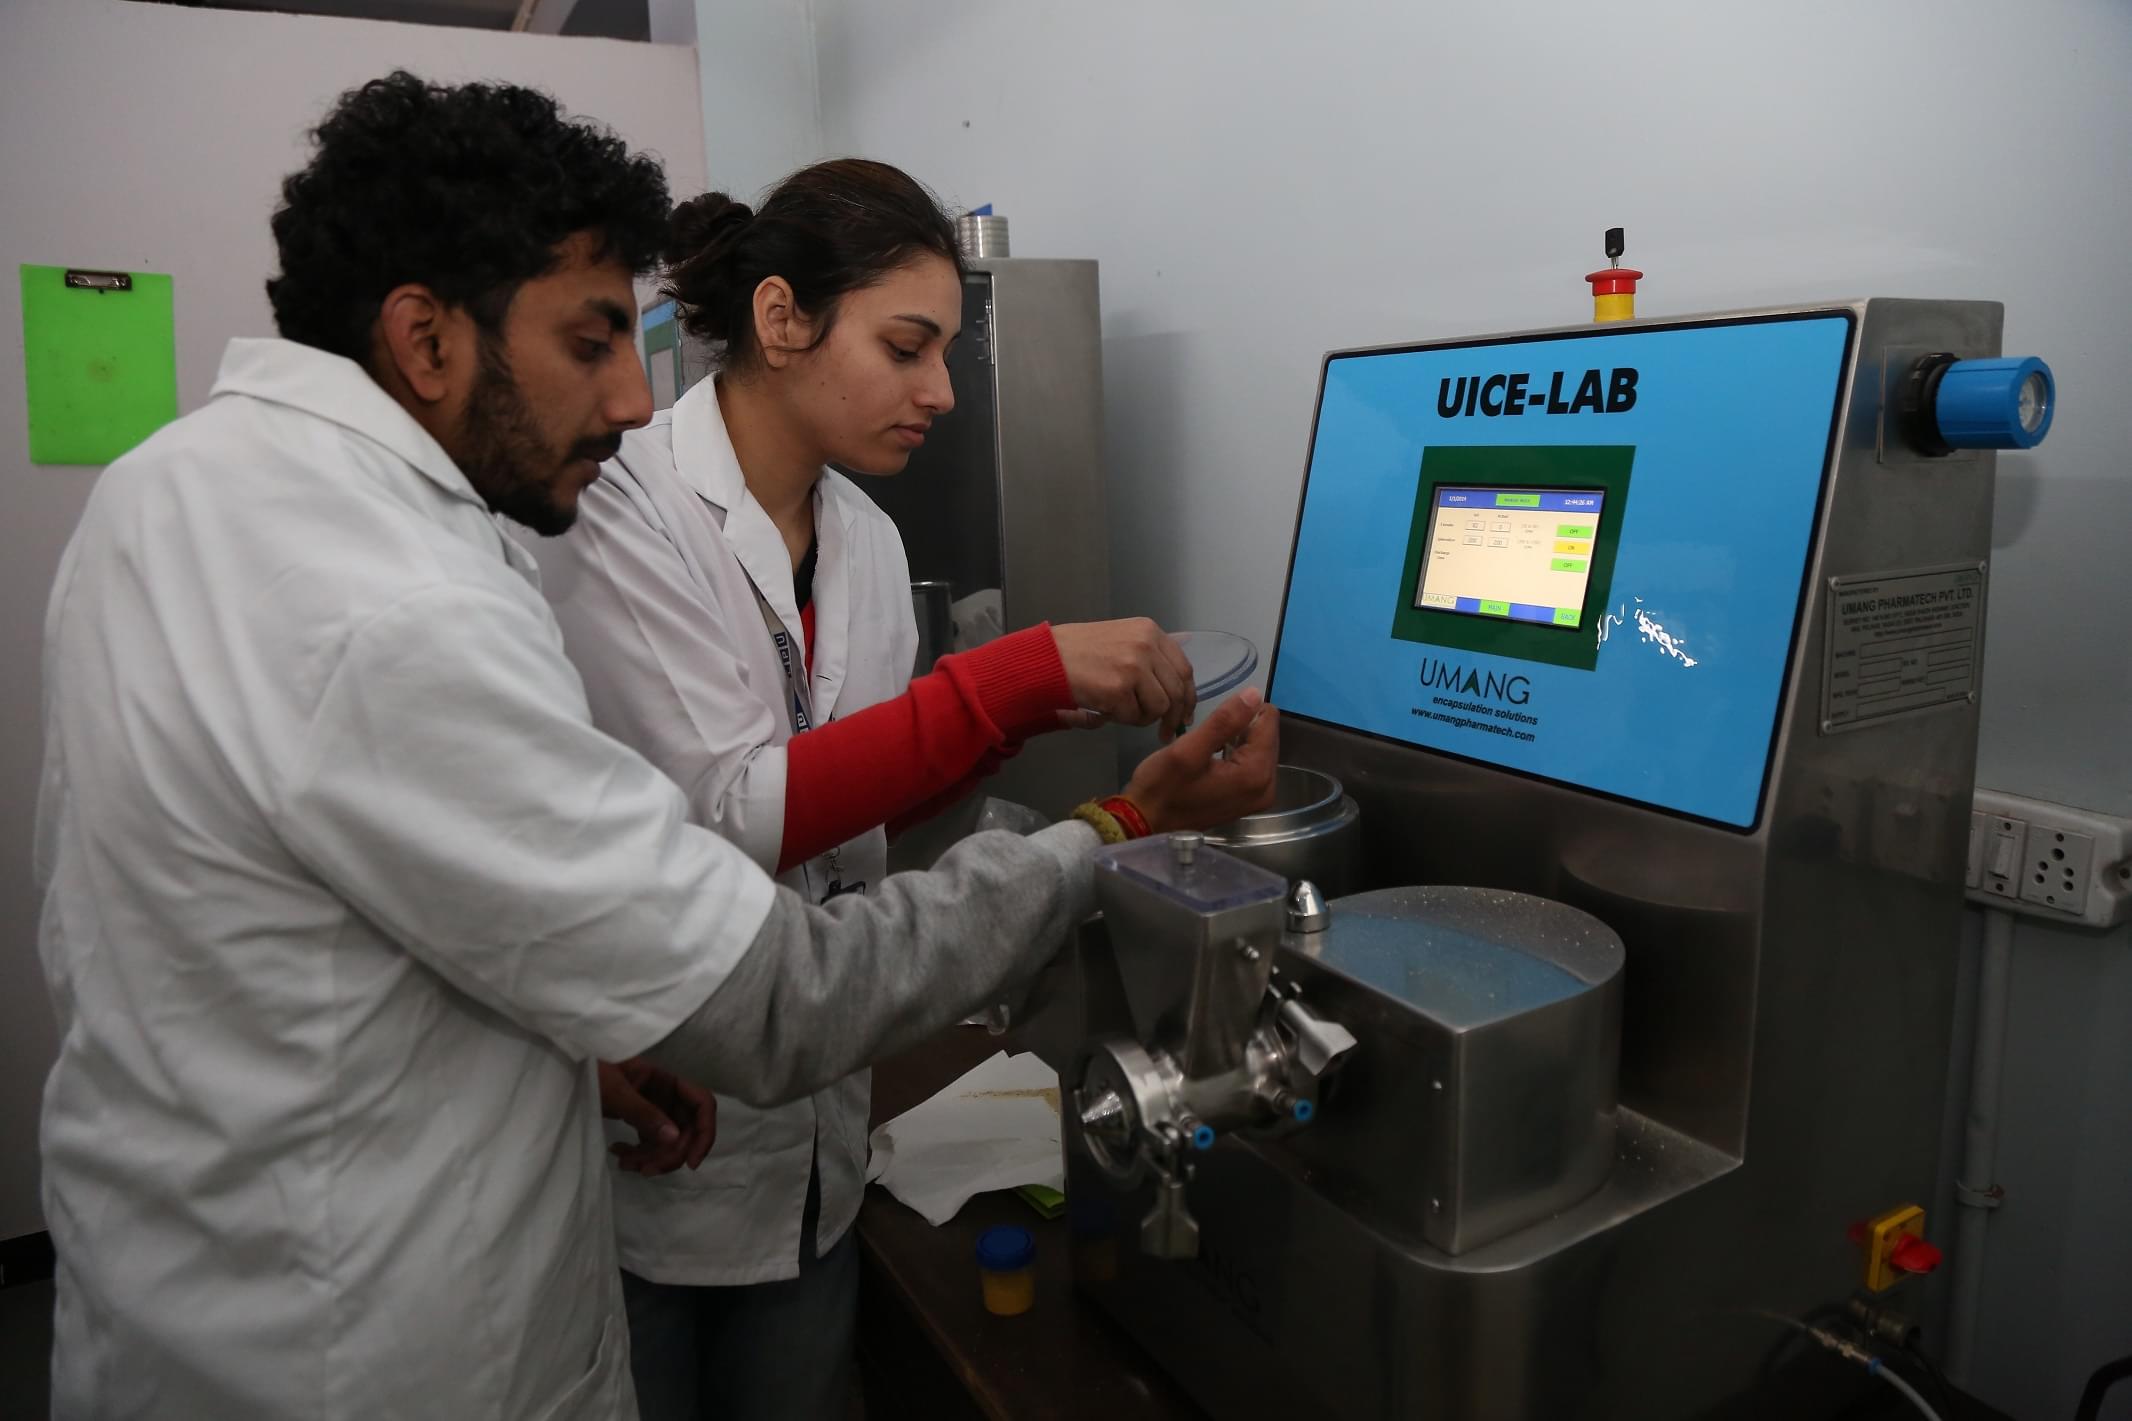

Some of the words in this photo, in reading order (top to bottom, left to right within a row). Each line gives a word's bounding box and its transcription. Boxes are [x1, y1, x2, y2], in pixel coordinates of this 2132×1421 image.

[1438, 368, 1639, 418] UICE-LAB
[1842, 599, 1877, 615] UMANG
[1878, 592, 1937, 610] PHARMATECH
[1420, 657, 1531, 704] UMANG
[1411, 706, 1536, 742] www.umangpharmatech.com
[1432, 695, 1493, 717] encapsulation
[1494, 709, 1539, 726] solutions
